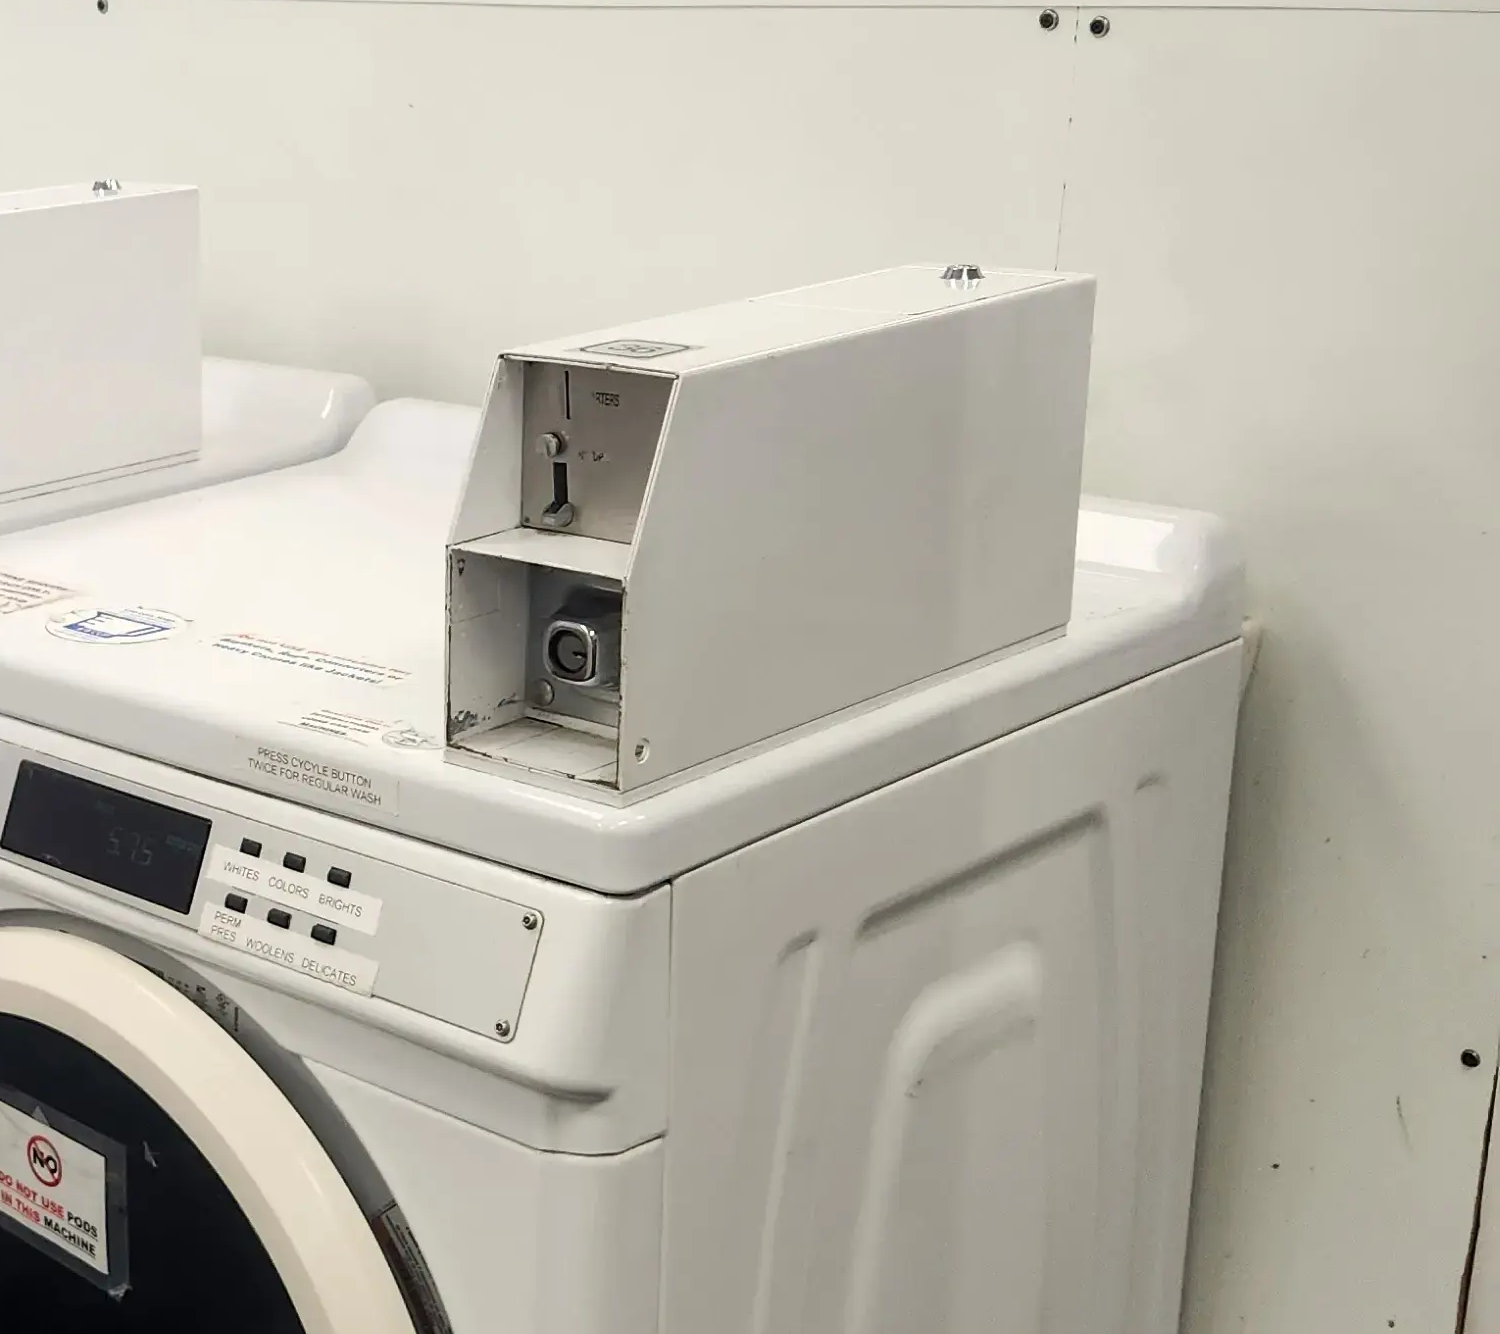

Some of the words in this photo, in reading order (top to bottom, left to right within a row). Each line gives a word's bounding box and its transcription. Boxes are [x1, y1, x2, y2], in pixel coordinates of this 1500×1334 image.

[248, 757, 278, 776] TWICE
[279, 767, 300, 782] FOR
[301, 774, 349, 797] REGULAR
[350, 788, 382, 805] WASH
[257, 747, 289, 765] PRESS
[291, 756, 329, 777] CYCYLE
[331, 768, 372, 789] BUTTON
[223, 861, 260, 882] WHITES
[268, 876, 310, 899] COLORS
[318, 893, 363, 918] BRIGHTS
[214, 910, 242, 928] PERM
[211, 925, 237, 943] PRES
[246, 937, 295, 964] WOOLENS
[301, 957, 357, 987] DELICATES
[0, 1189, 13, 1205] IN
[15, 1198, 40, 1223] THIS
[43, 1215, 96, 1257] MACHINE
[16, 1179, 38, 1202] NOT
[41, 1195, 64, 1217] USE
[67, 1211, 98, 1238] PODS
